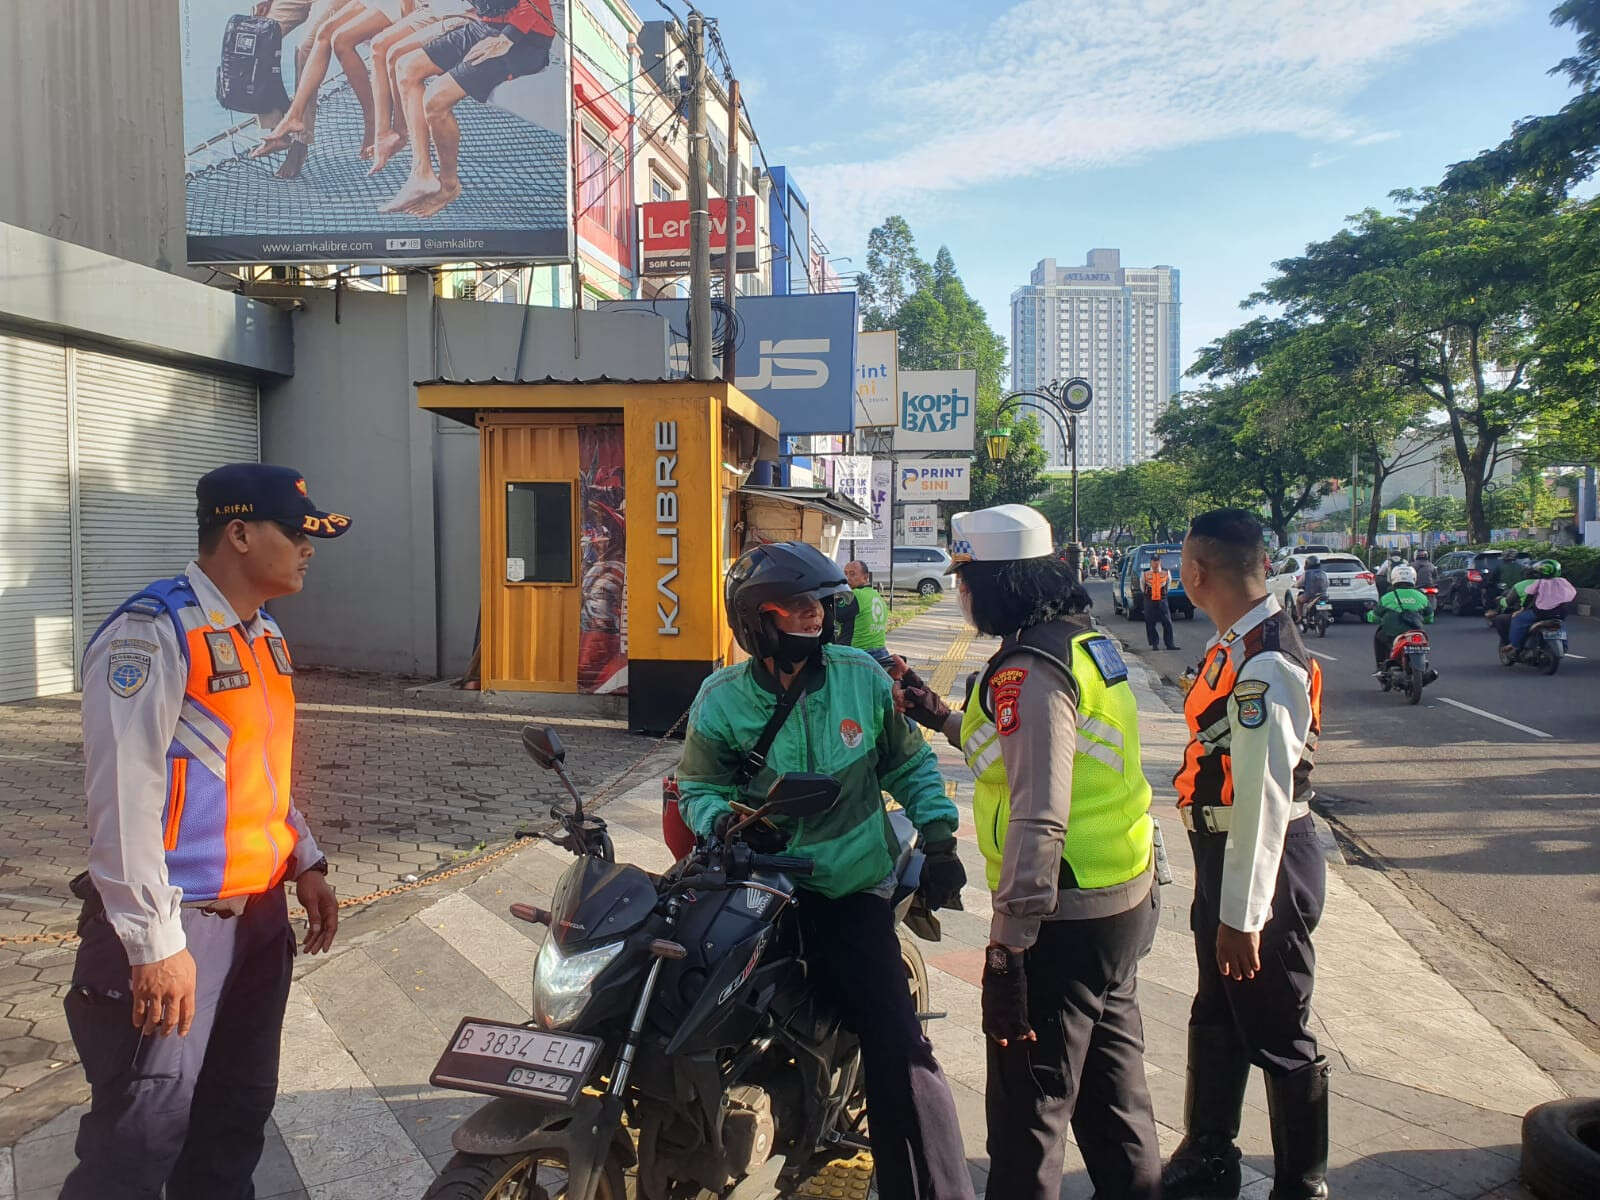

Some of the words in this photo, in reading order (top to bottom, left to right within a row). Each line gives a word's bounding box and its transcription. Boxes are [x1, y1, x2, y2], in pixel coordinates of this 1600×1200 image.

[648, 216, 747, 239] Lenvo
[262, 240, 373, 252] www.iamkalibre.com
[424, 238, 484, 249] @iamkalibre
[649, 261, 668, 269] SGM
[921, 468, 963, 478] PRINT
[921, 480, 949, 490] SINI
[656, 421, 679, 636] KALIBRE
[458, 1029, 474, 1049] B
[480, 1031, 535, 1057] 3834
[543, 1041, 586, 1068] ELA
